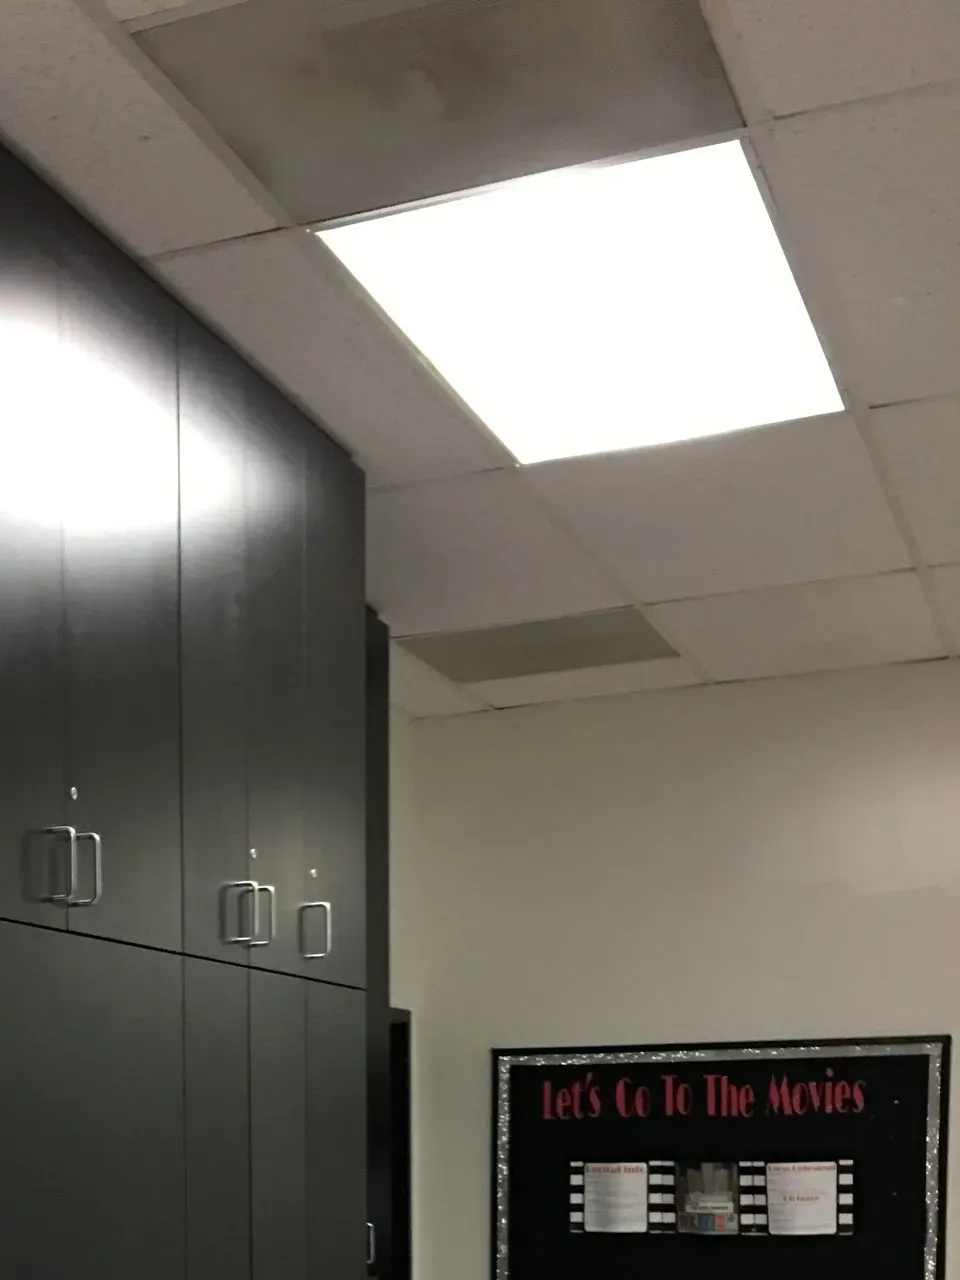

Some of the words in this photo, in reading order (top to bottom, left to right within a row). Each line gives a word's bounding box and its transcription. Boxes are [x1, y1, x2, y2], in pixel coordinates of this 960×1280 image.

[542, 1072, 602, 1120] Let's
[615, 1076, 652, 1119] Go
[661, 1074, 694, 1117] To
[703, 1073, 756, 1119] The
[764, 1066, 867, 1118] Movies
